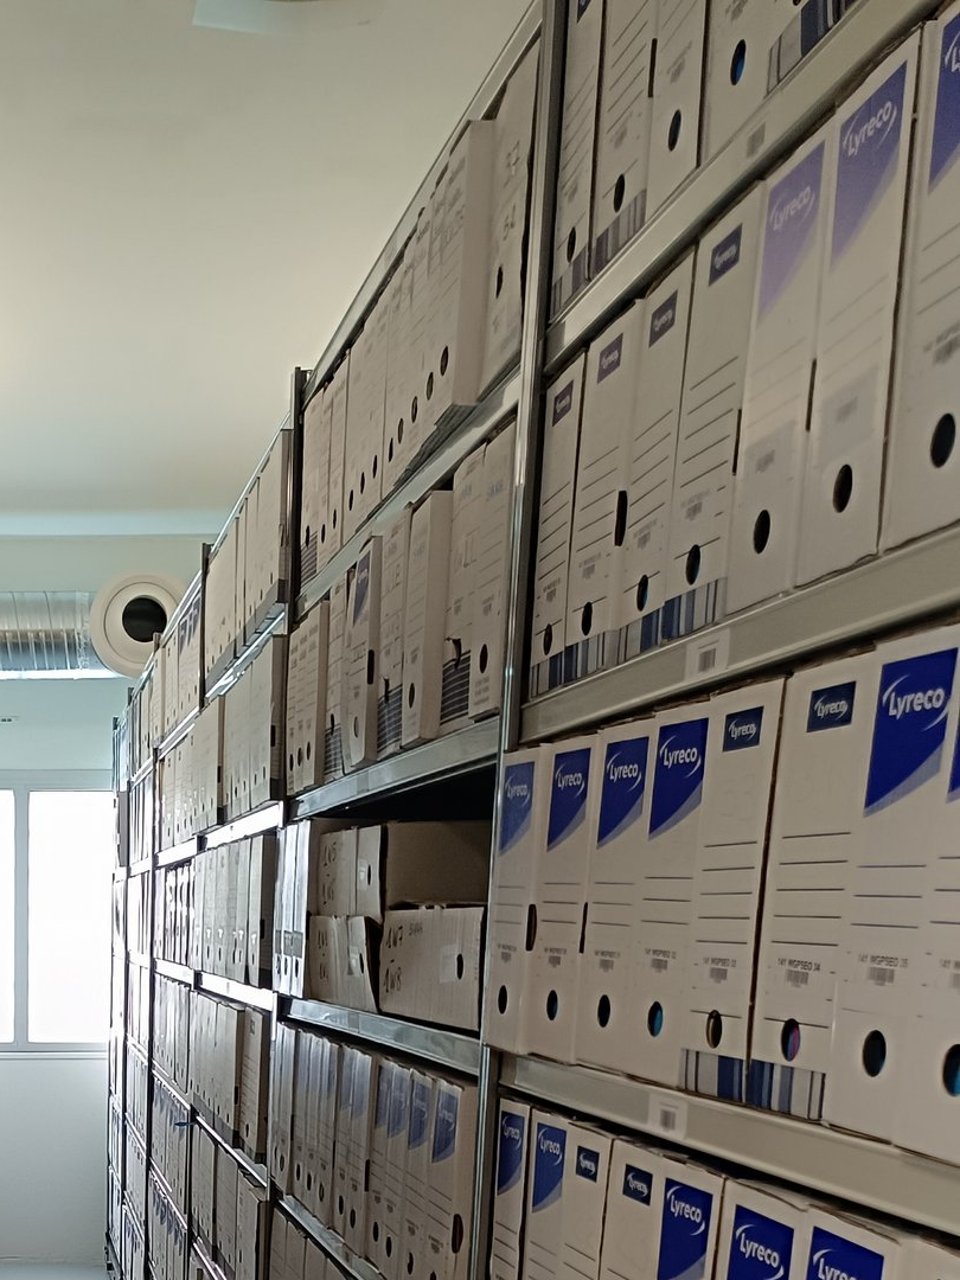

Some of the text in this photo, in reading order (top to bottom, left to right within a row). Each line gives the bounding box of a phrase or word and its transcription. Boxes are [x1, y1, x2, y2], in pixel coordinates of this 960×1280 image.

[847, 101, 893, 158] Lyreco
[772, 186, 812, 231] Lyreco
[817, 699, 847, 720] Lyreco
[888, 687, 945, 720] Lyreco
[730, 722, 755, 741] Lyreco
[663, 747, 699, 769] Lyreco
[557, 771, 583, 791] Lyreco
[609, 761, 639, 783] Lyreco
[506, 782, 528, 798] Lyreco
[503, 1123, 520, 1140] Lyreco
[540, 1135, 561, 1155] Lyreco
[670, 1194, 702, 1223] Lyreco
[740, 1232, 780, 1268] Lyreco
